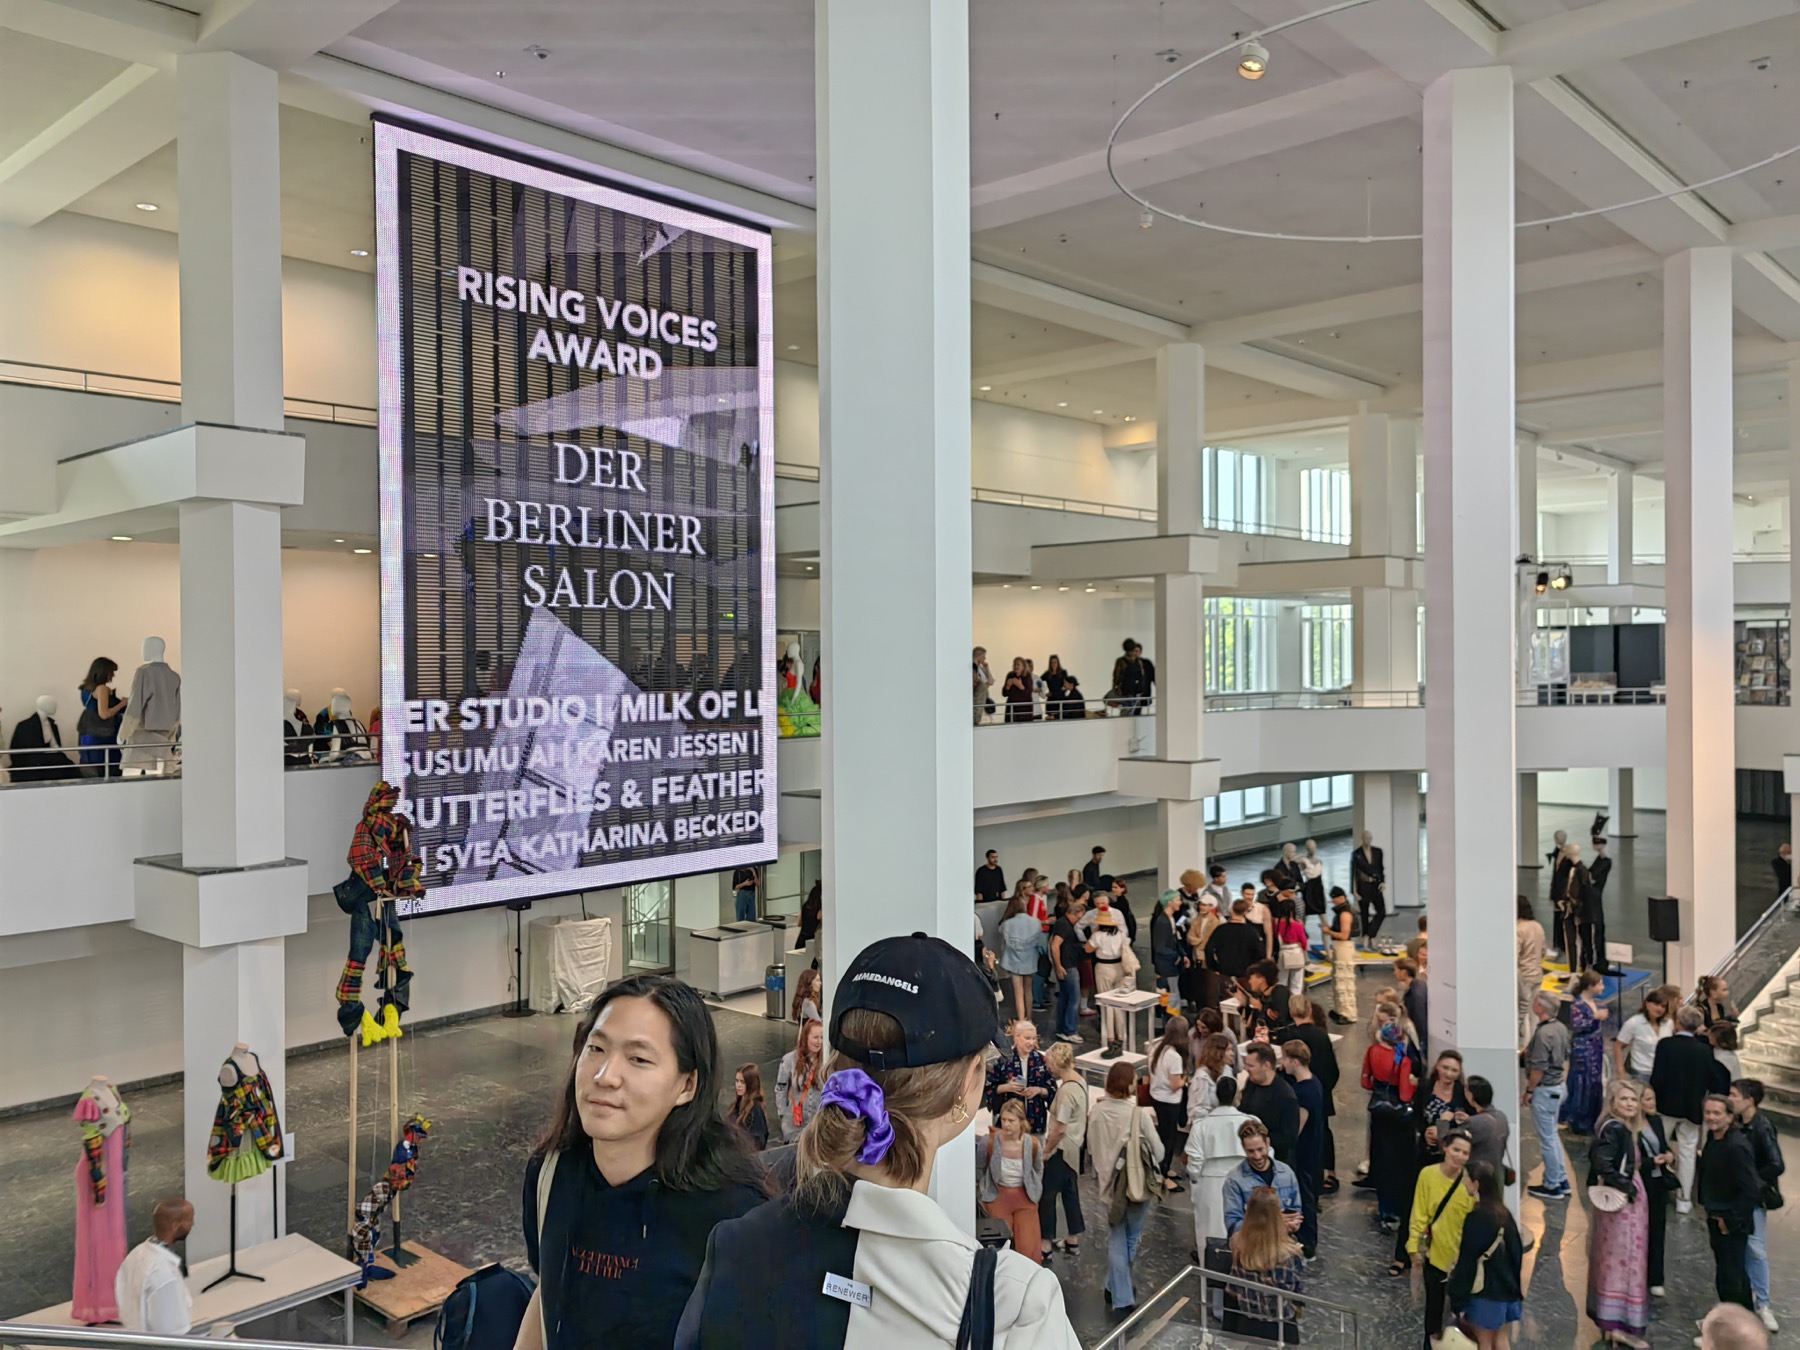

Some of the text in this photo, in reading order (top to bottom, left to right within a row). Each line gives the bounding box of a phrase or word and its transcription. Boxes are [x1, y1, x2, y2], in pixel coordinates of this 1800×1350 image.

[457, 265, 718, 352] RISING VOICES
[527, 328, 663, 380] AWARD
[553, 442, 647, 493] DER
[482, 498, 707, 555] BERLINER
[523, 565, 675, 611] SALON
[458, 695, 587, 731] STUDIO
[621, 692, 695, 723] MILK
[698, 690, 738, 719] OF
[577, 737, 662, 767] KAREN
[667, 731, 748, 759] JESSEN
[620, 778, 643, 809] &
[434, 838, 513, 872] SVEA
[521, 822, 668, 858] KATHARINA
[673, 810, 764, 842] BECKED
